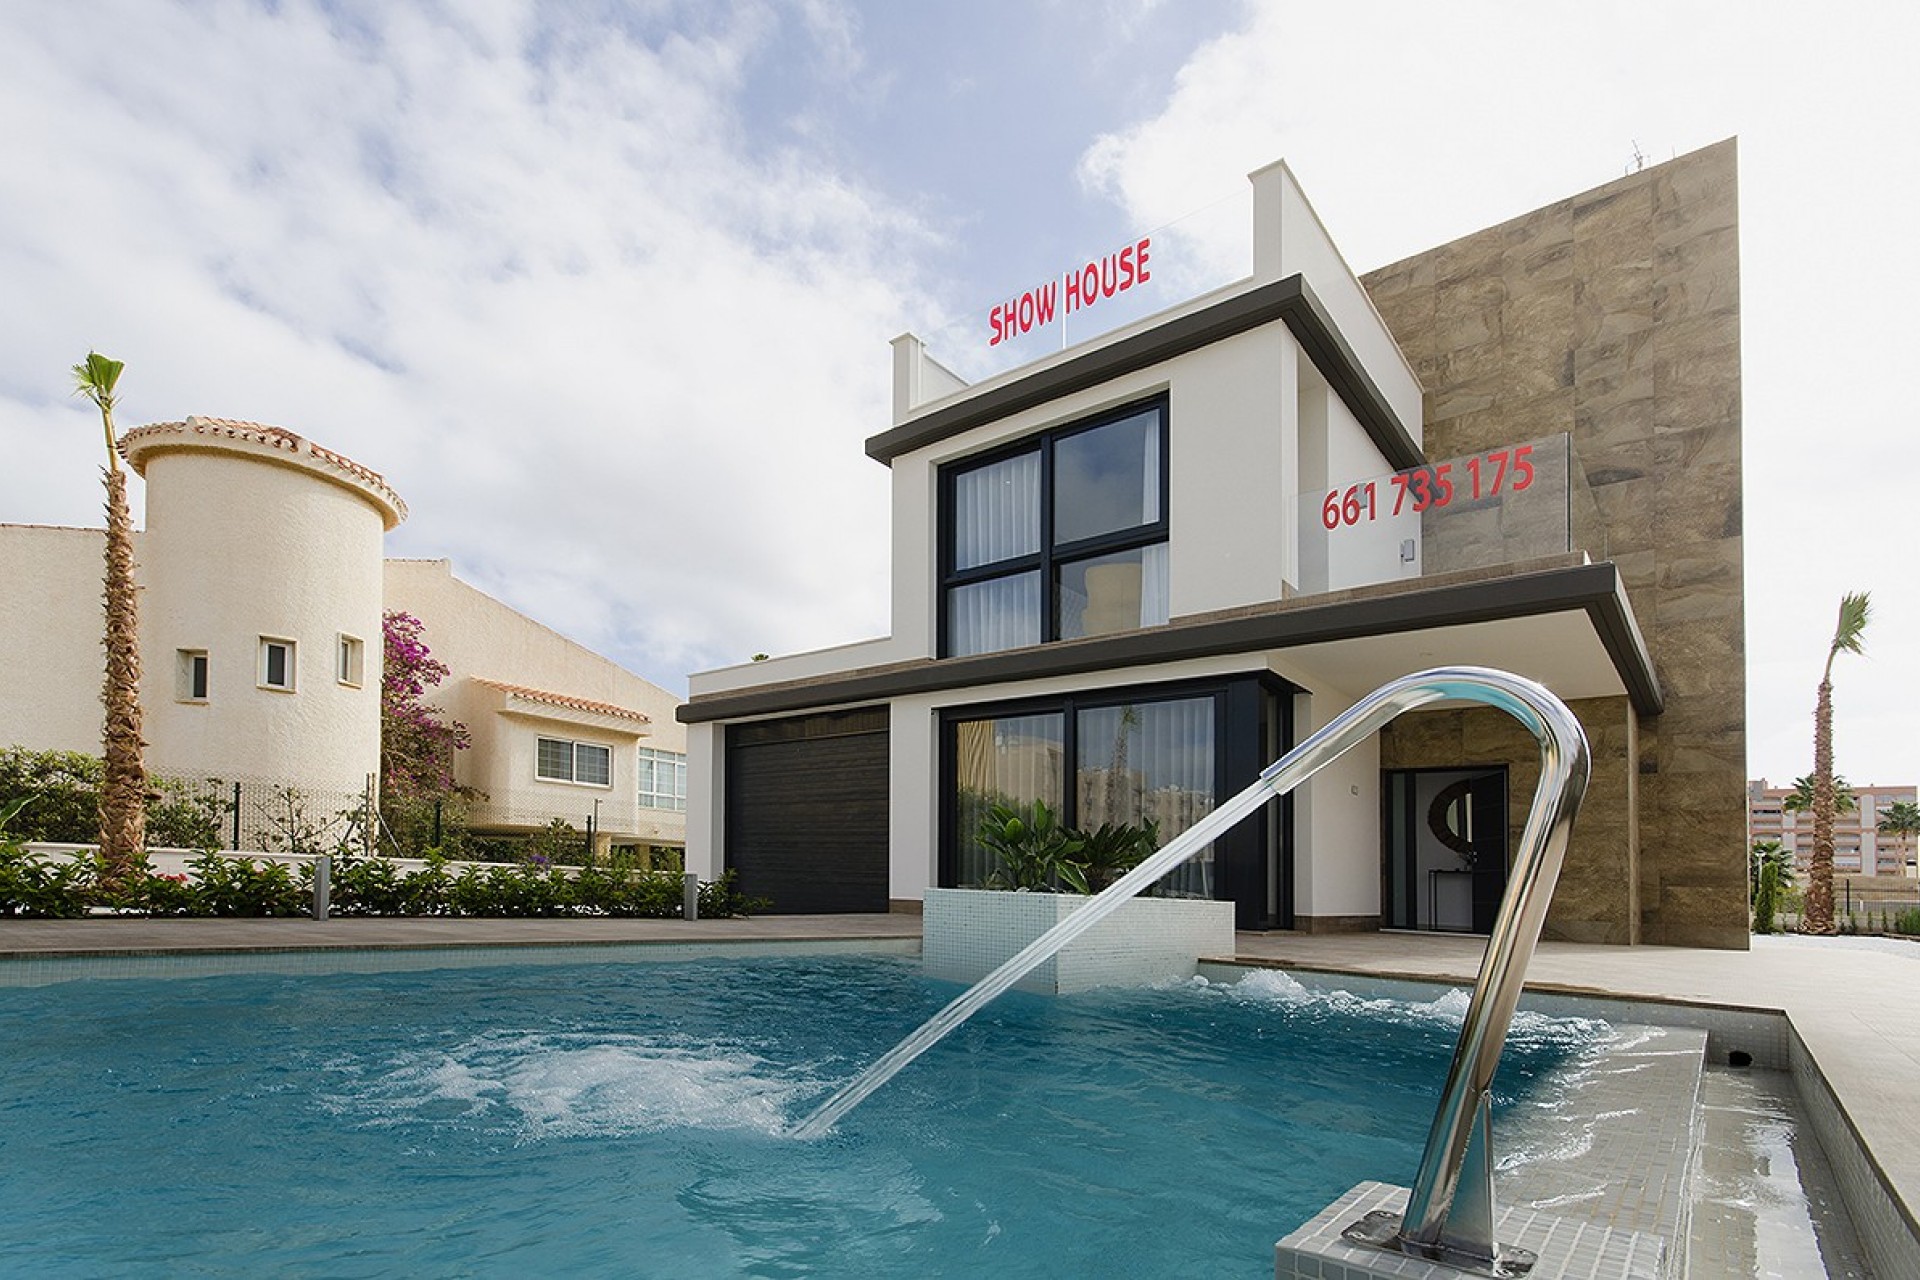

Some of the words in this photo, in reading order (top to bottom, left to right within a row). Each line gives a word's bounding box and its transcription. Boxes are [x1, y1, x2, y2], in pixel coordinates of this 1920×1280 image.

[988, 282, 1057, 347] SHOW
[1065, 238, 1152, 315] HOUSE
[1322, 483, 1377, 530] 661
[1390, 463, 1454, 516] 735
[1466, 445, 1535, 500] 175
